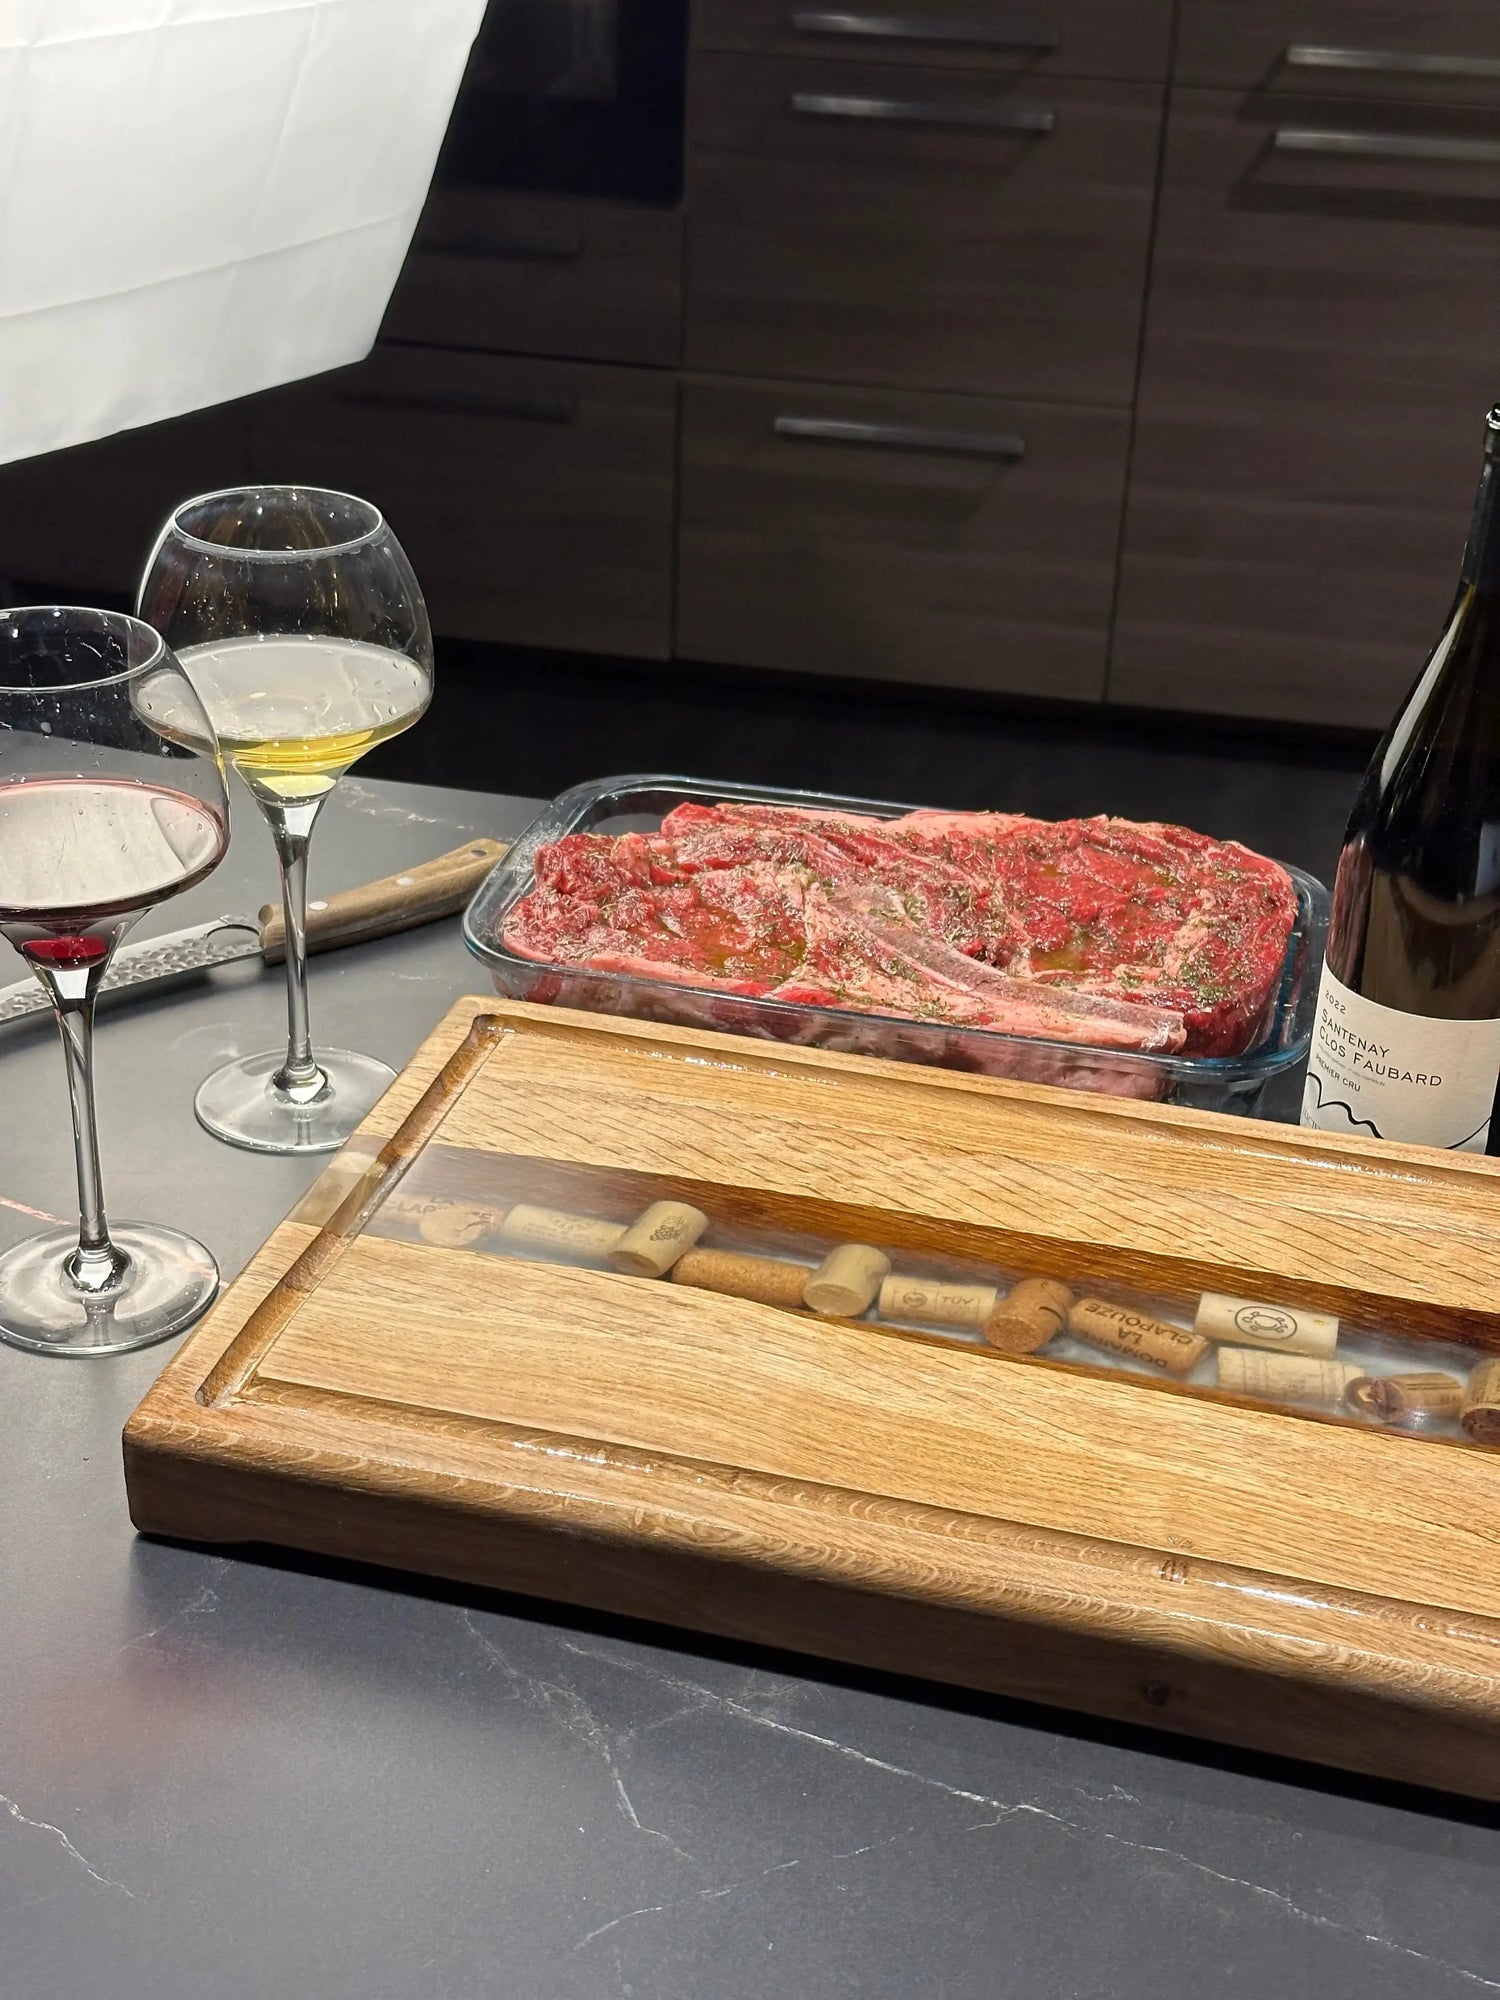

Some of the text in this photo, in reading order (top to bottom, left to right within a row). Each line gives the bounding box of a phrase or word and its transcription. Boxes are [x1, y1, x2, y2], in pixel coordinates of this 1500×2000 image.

[1325, 989, 1346, 1015] 2022
[1322, 1008, 1390, 1058] SANTENAY
[1315, 1053, 1340, 1081] PREMIER
[1342, 1077, 1361, 1092] CRU
[1319, 1026, 1346, 1058] CLOS
[1353, 1053, 1442, 1087] FAUBARD
[1085, 1302, 1193, 1345] CLAPOUZE
[1118, 1326, 1142, 1345] LA
